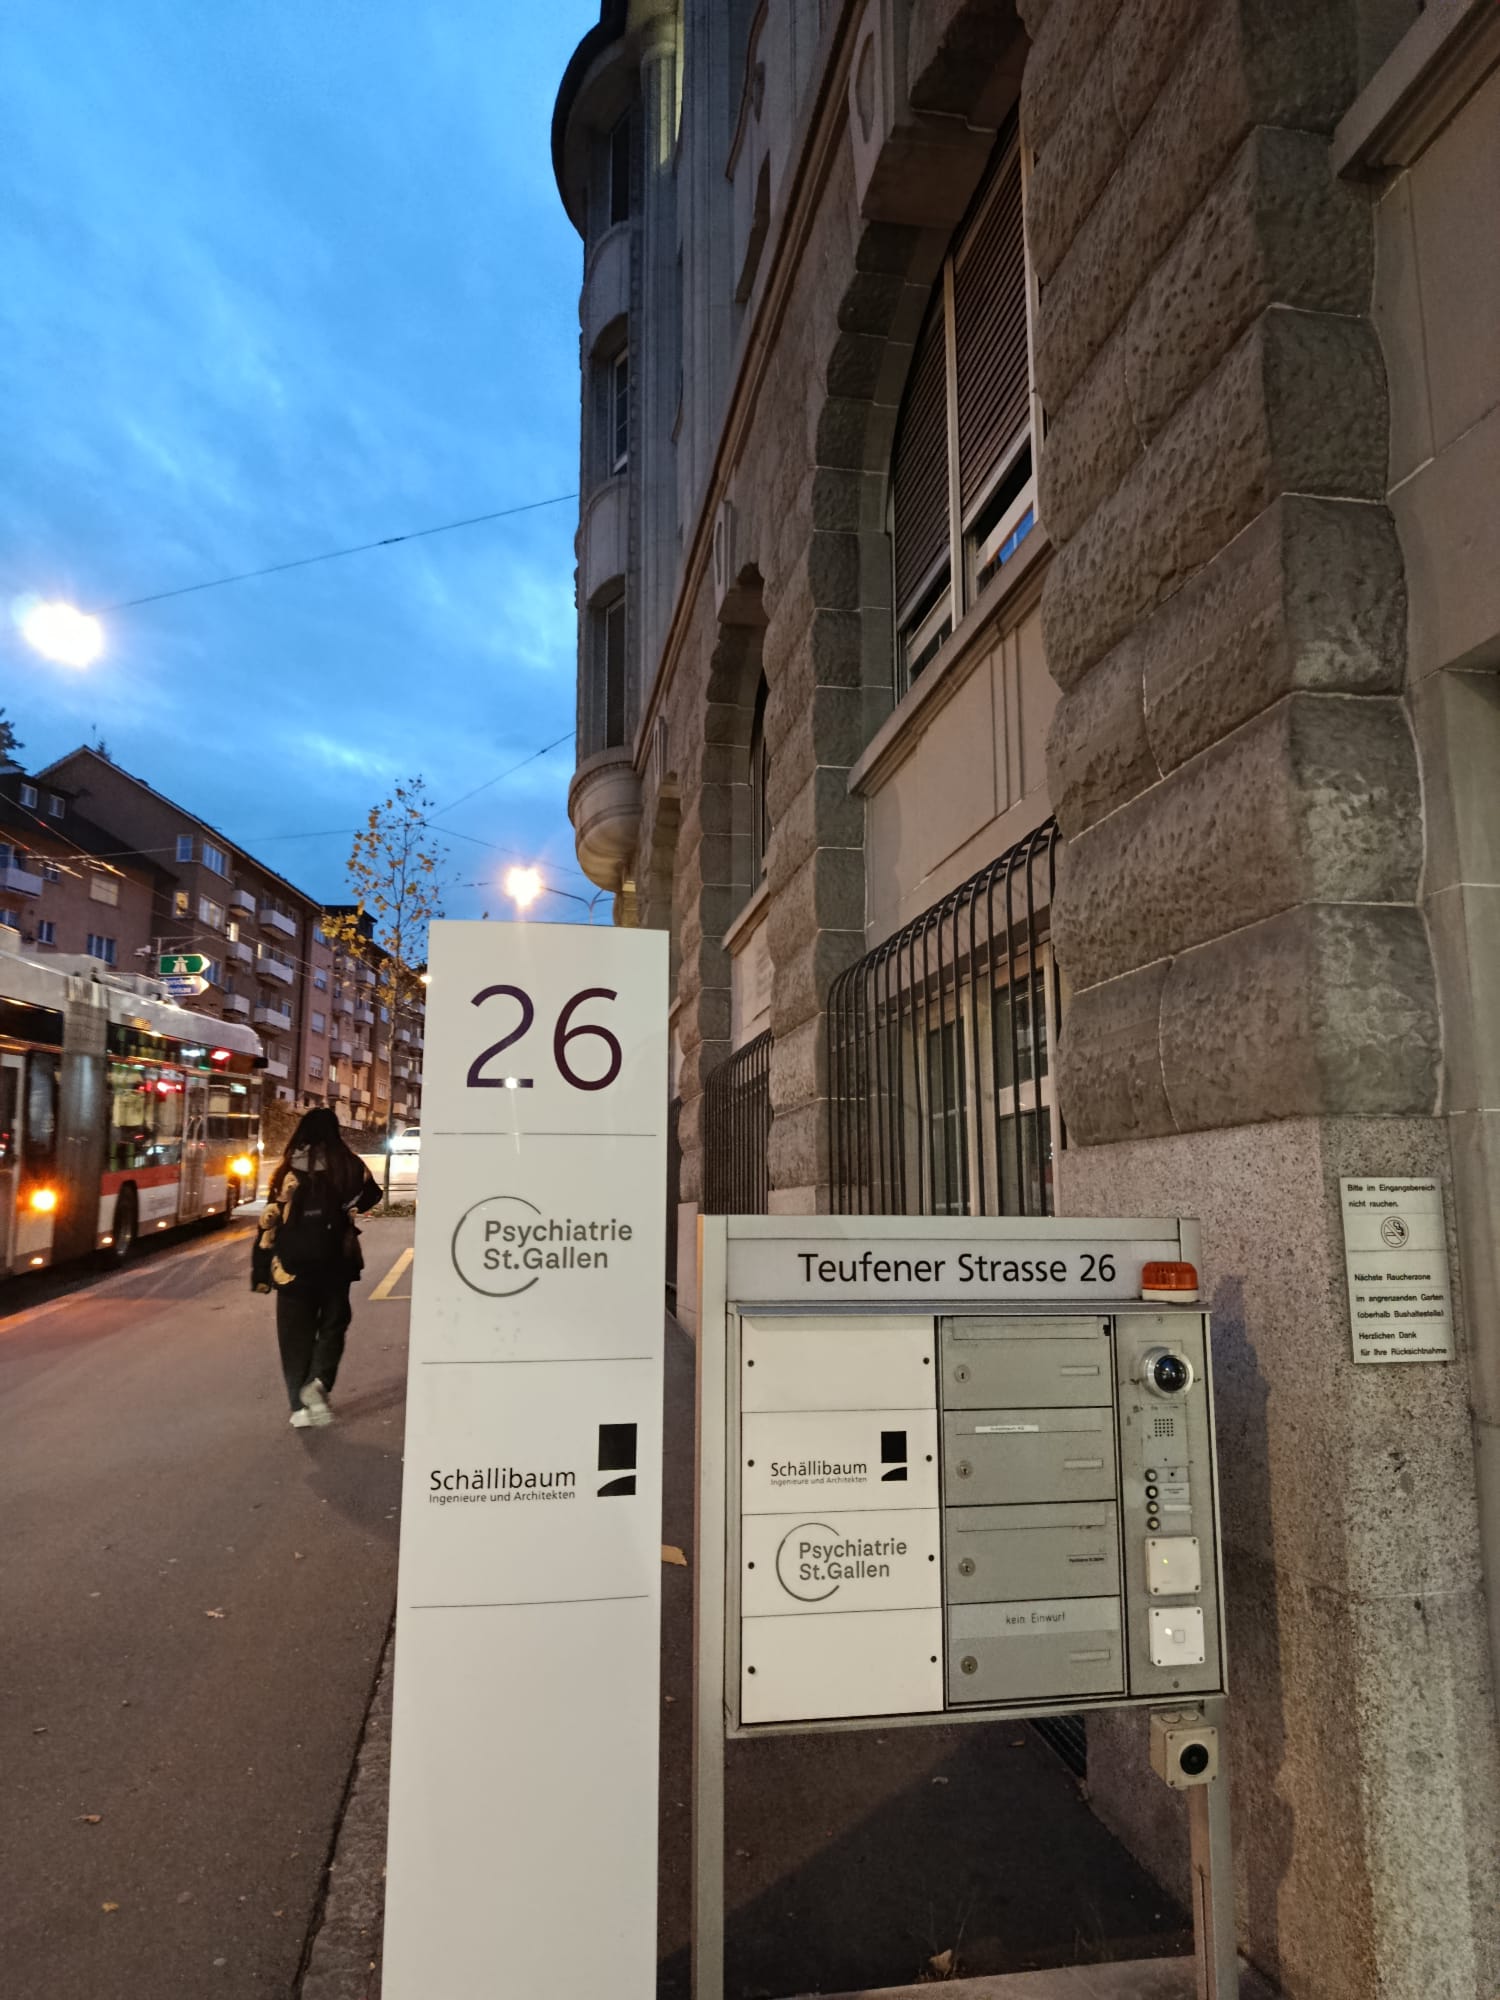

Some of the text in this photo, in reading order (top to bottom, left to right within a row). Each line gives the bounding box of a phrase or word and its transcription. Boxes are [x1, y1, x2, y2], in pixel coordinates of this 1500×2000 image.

[466, 984, 622, 1091] 26
[1379, 1184, 1436, 1192] Eingangsbereich
[484, 1217, 633, 1248] Psychiatrie
[483, 1247, 609, 1271] St.Gallen
[797, 1251, 1116, 1283] Teufener Strasse 26
[1369, 1294, 1417, 1303] angrenzenden
[1359, 1332, 1395, 1340] Herzlichen
[771, 1460, 867, 1477] Schällibaum
[430, 1468, 576, 1491] Schällibaum
[770, 1478, 809, 1487] Ingenieure
[429, 1489, 576, 1505] Ingenieure und Architekten
[799, 1538, 907, 1563] Psychiatrie
[799, 1561, 890, 1581] St.Gallen
[1006, 1612, 1065, 1624] kein Einwurf
